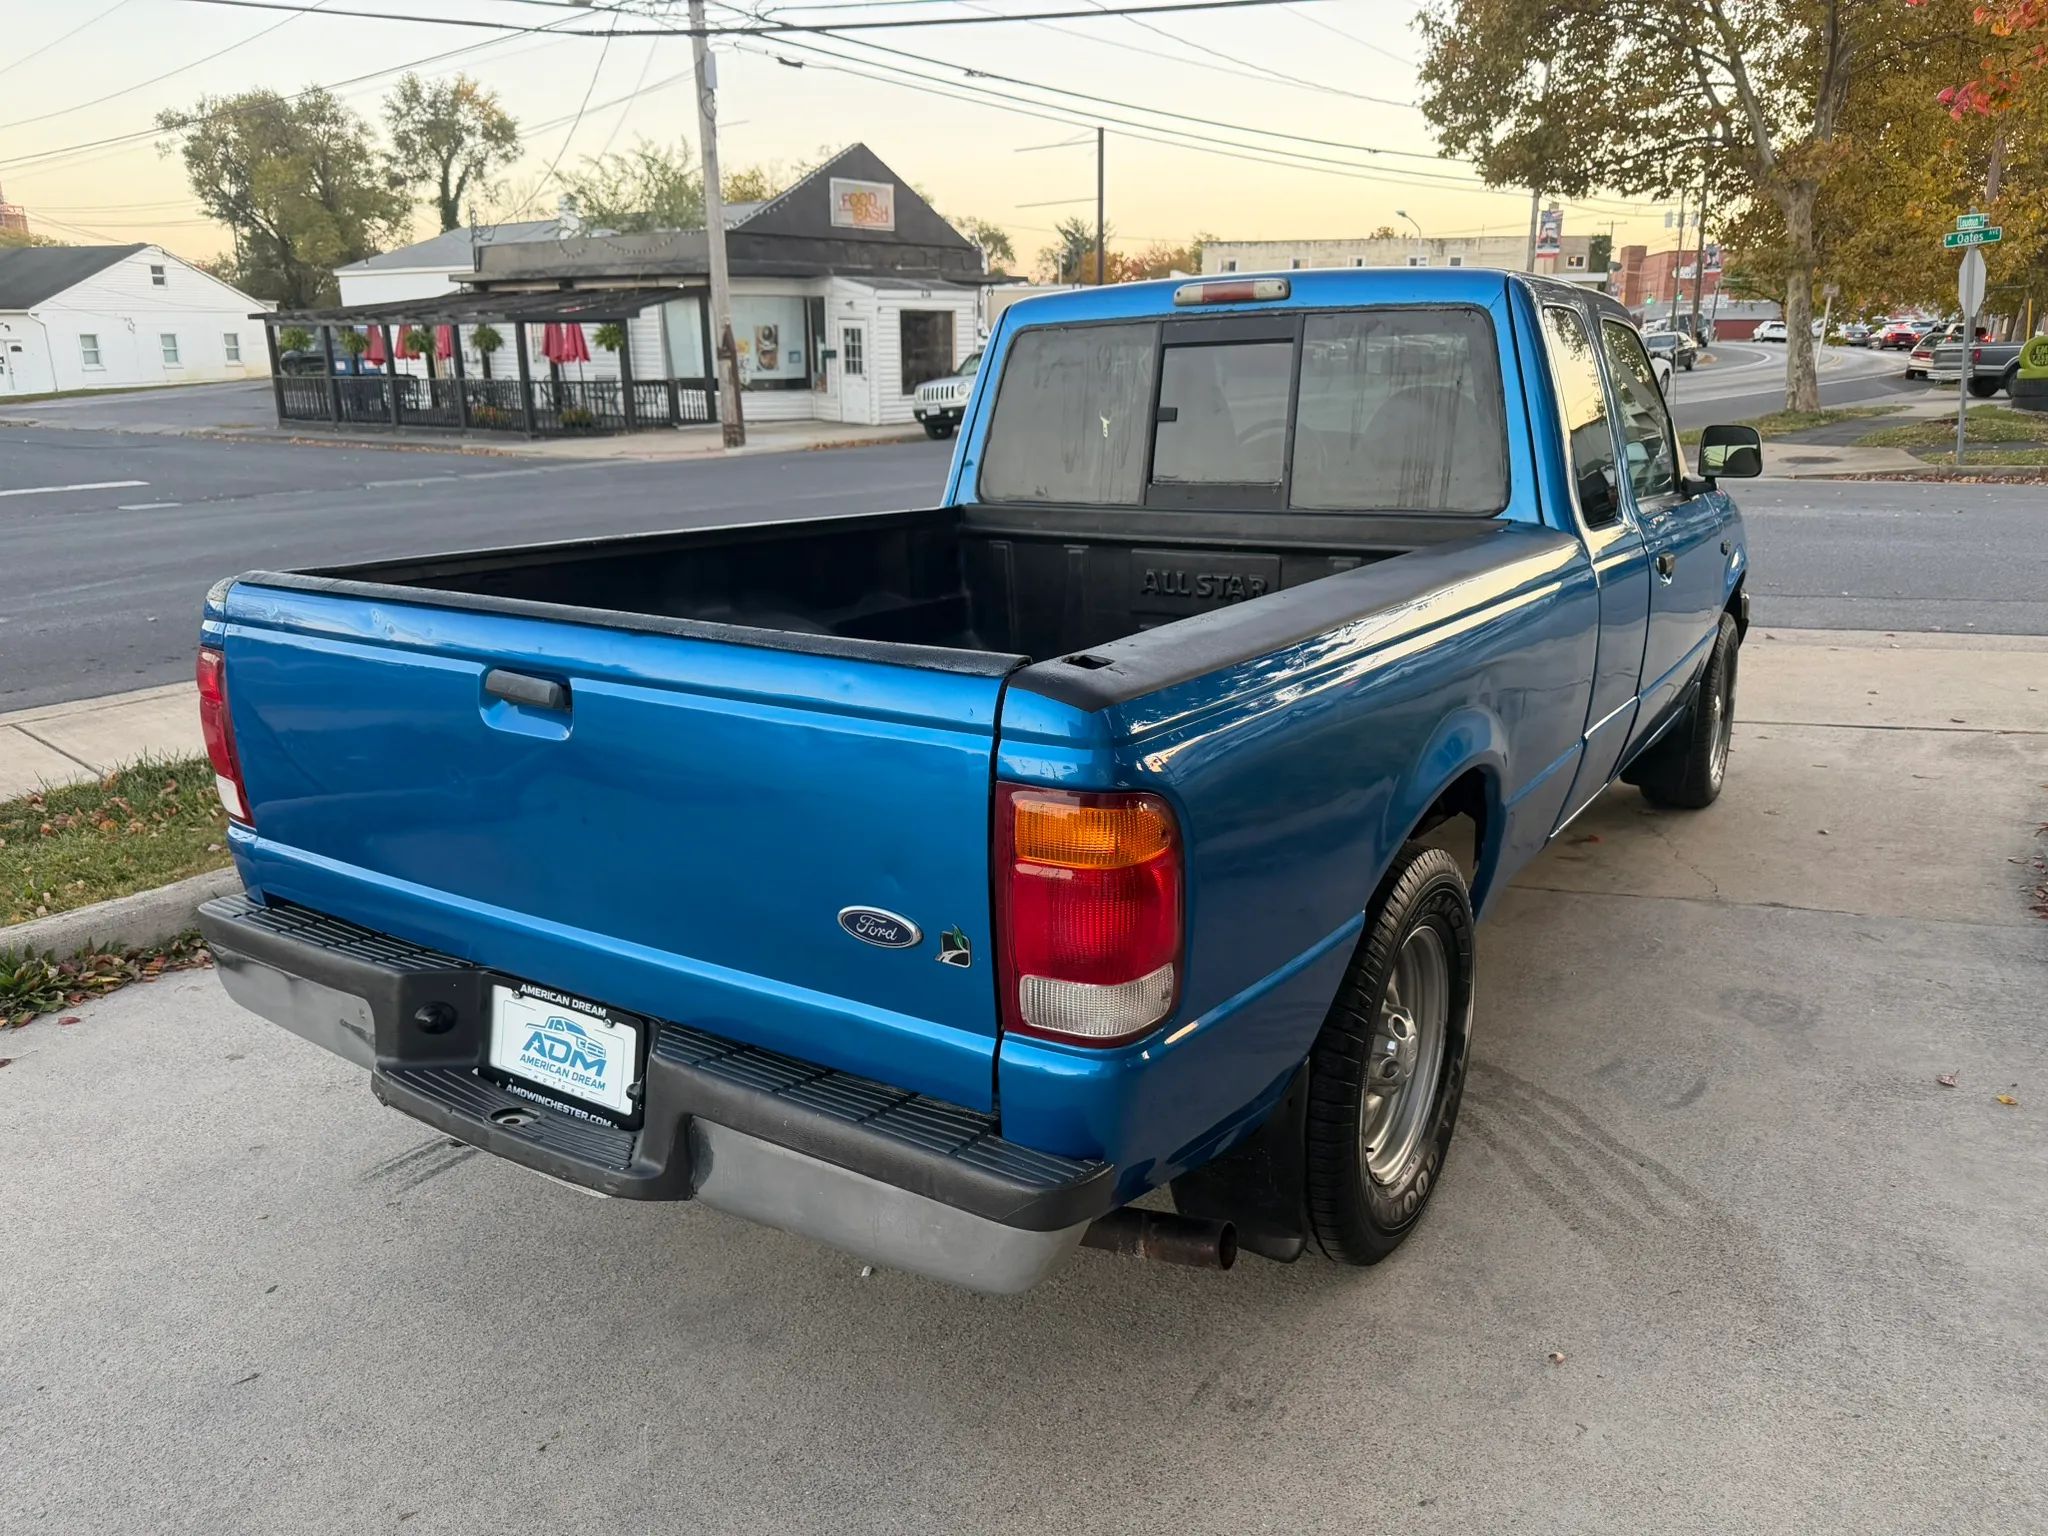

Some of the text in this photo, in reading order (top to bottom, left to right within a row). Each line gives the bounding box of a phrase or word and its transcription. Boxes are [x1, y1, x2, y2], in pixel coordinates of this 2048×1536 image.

[1957, 232, 1984, 244] Oates
[1141, 568, 1191, 595] ALL
[856, 914, 898, 941] Ford
[520, 984, 607, 1017] AMERICAN DREAM
[522, 1031, 607, 1077] ADM
[519, 1053, 606, 1091] AMERICAN DREAM
[505, 1083, 612, 1128] AMDWINCHESTER.COM
